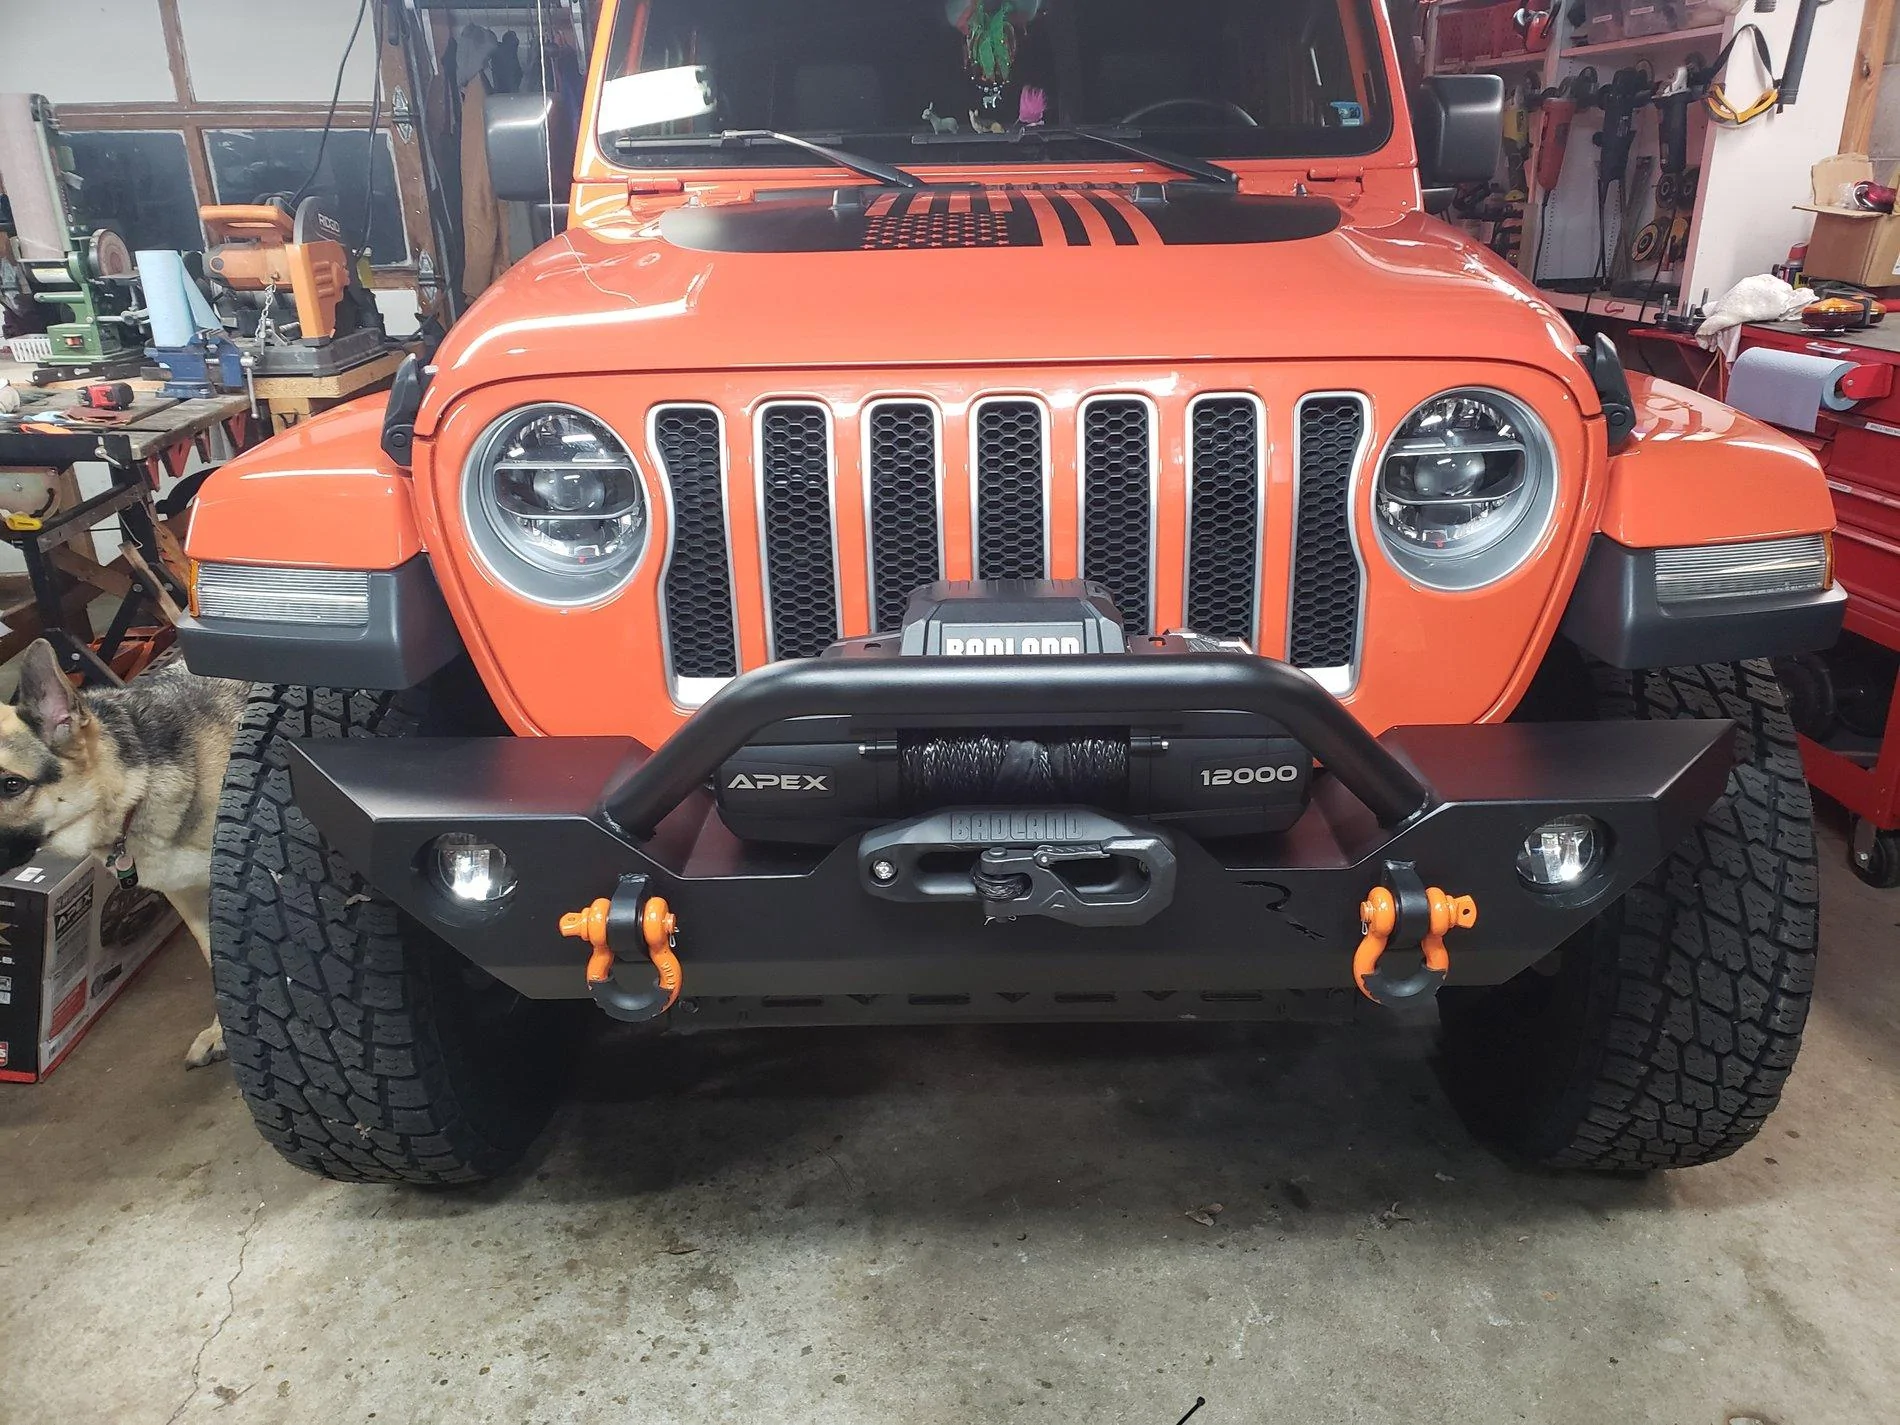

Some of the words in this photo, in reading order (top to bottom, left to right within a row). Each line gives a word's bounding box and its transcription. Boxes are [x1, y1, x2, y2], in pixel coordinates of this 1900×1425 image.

[727, 773, 829, 790] APEX
[1200, 765, 1298, 786] 12000
[950, 812, 1083, 841] BADLAND
